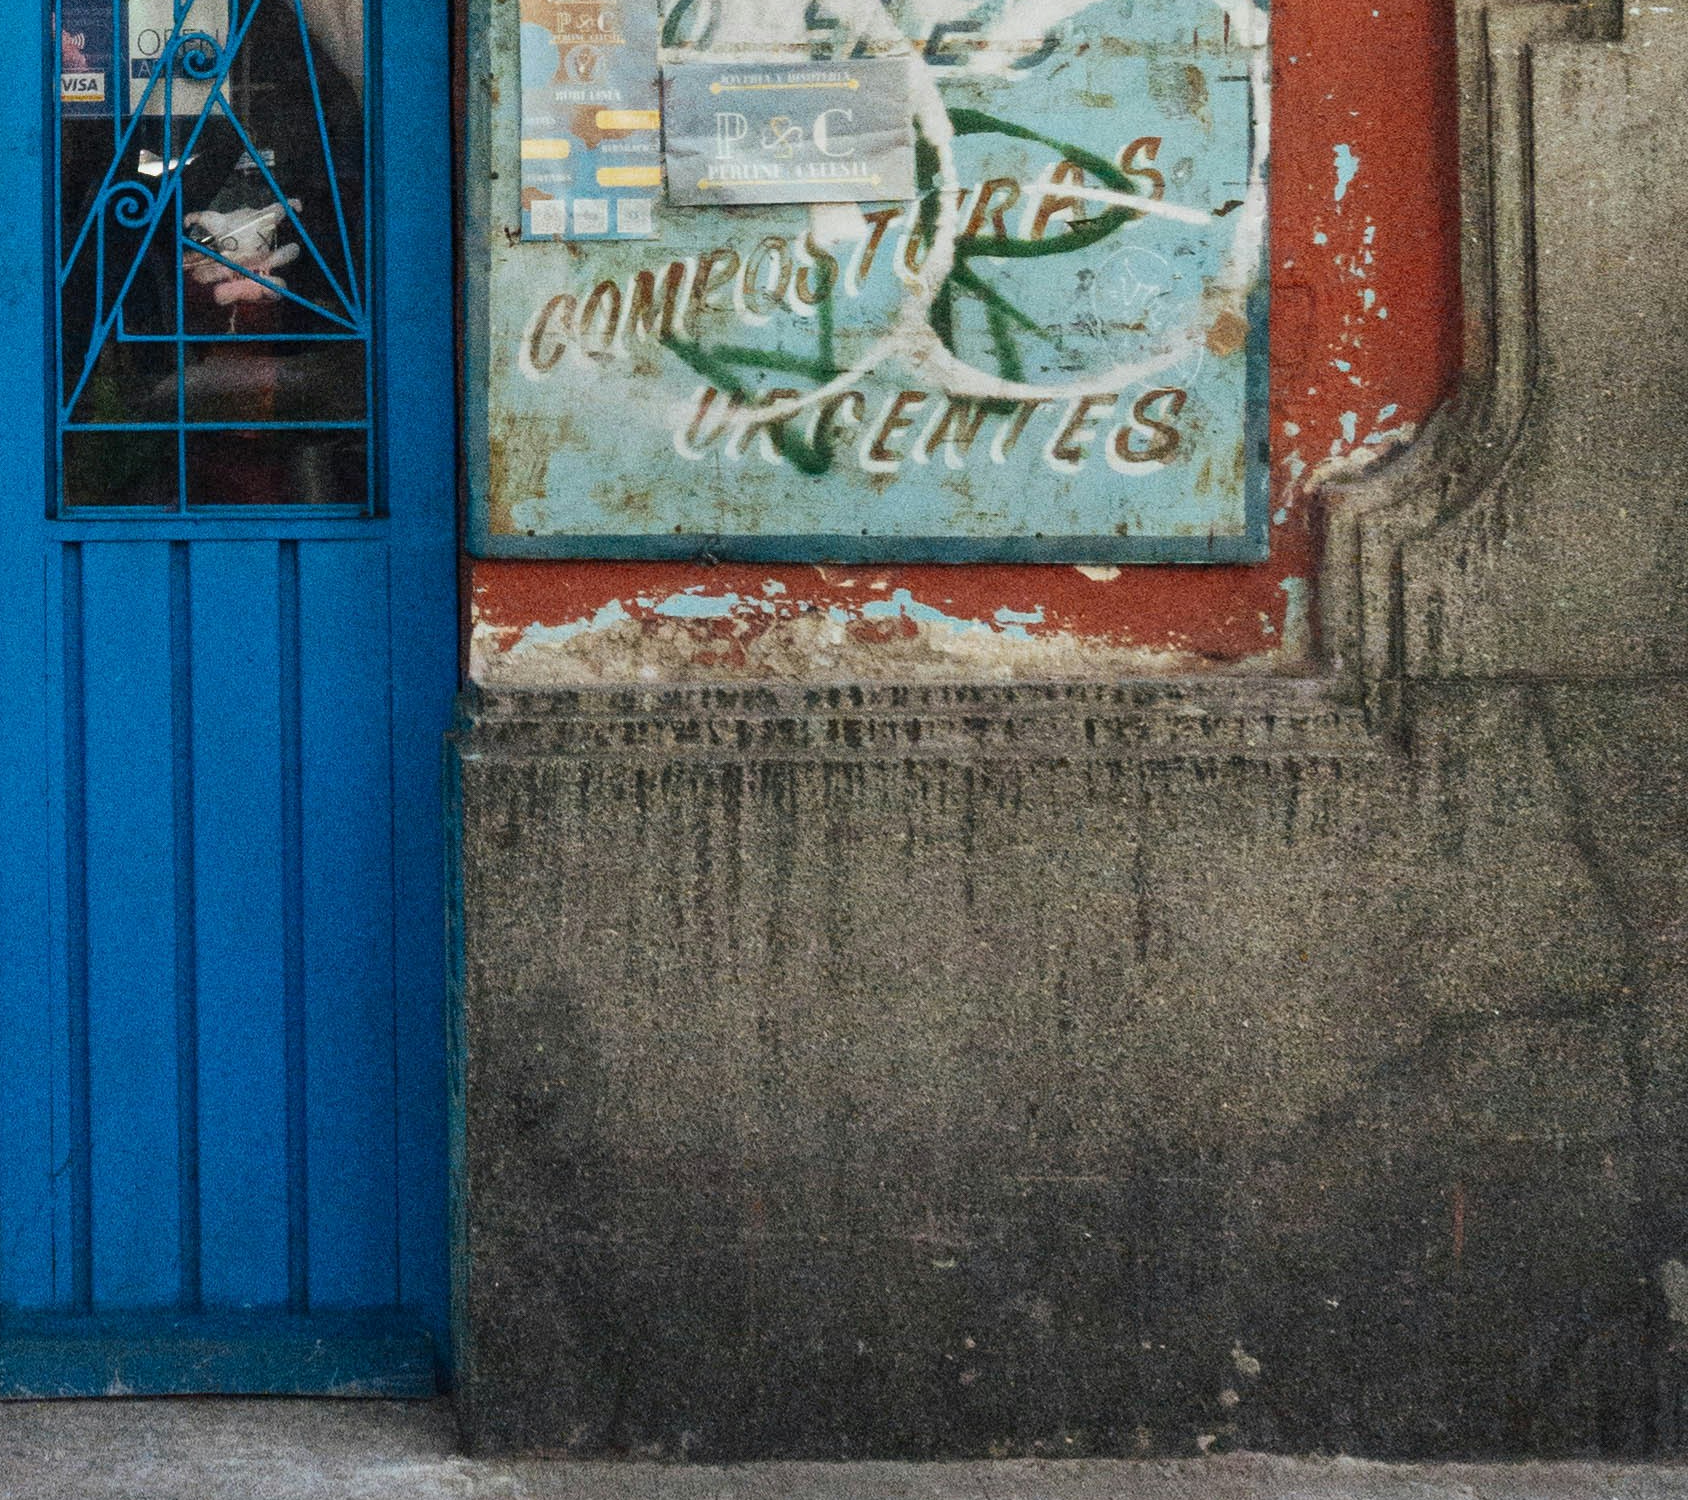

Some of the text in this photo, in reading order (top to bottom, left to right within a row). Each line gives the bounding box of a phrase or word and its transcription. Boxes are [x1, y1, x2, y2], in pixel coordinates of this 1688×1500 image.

[61, 78, 99, 92] VISA
[714, 111, 749, 161] P
[812, 107, 858, 159] C
